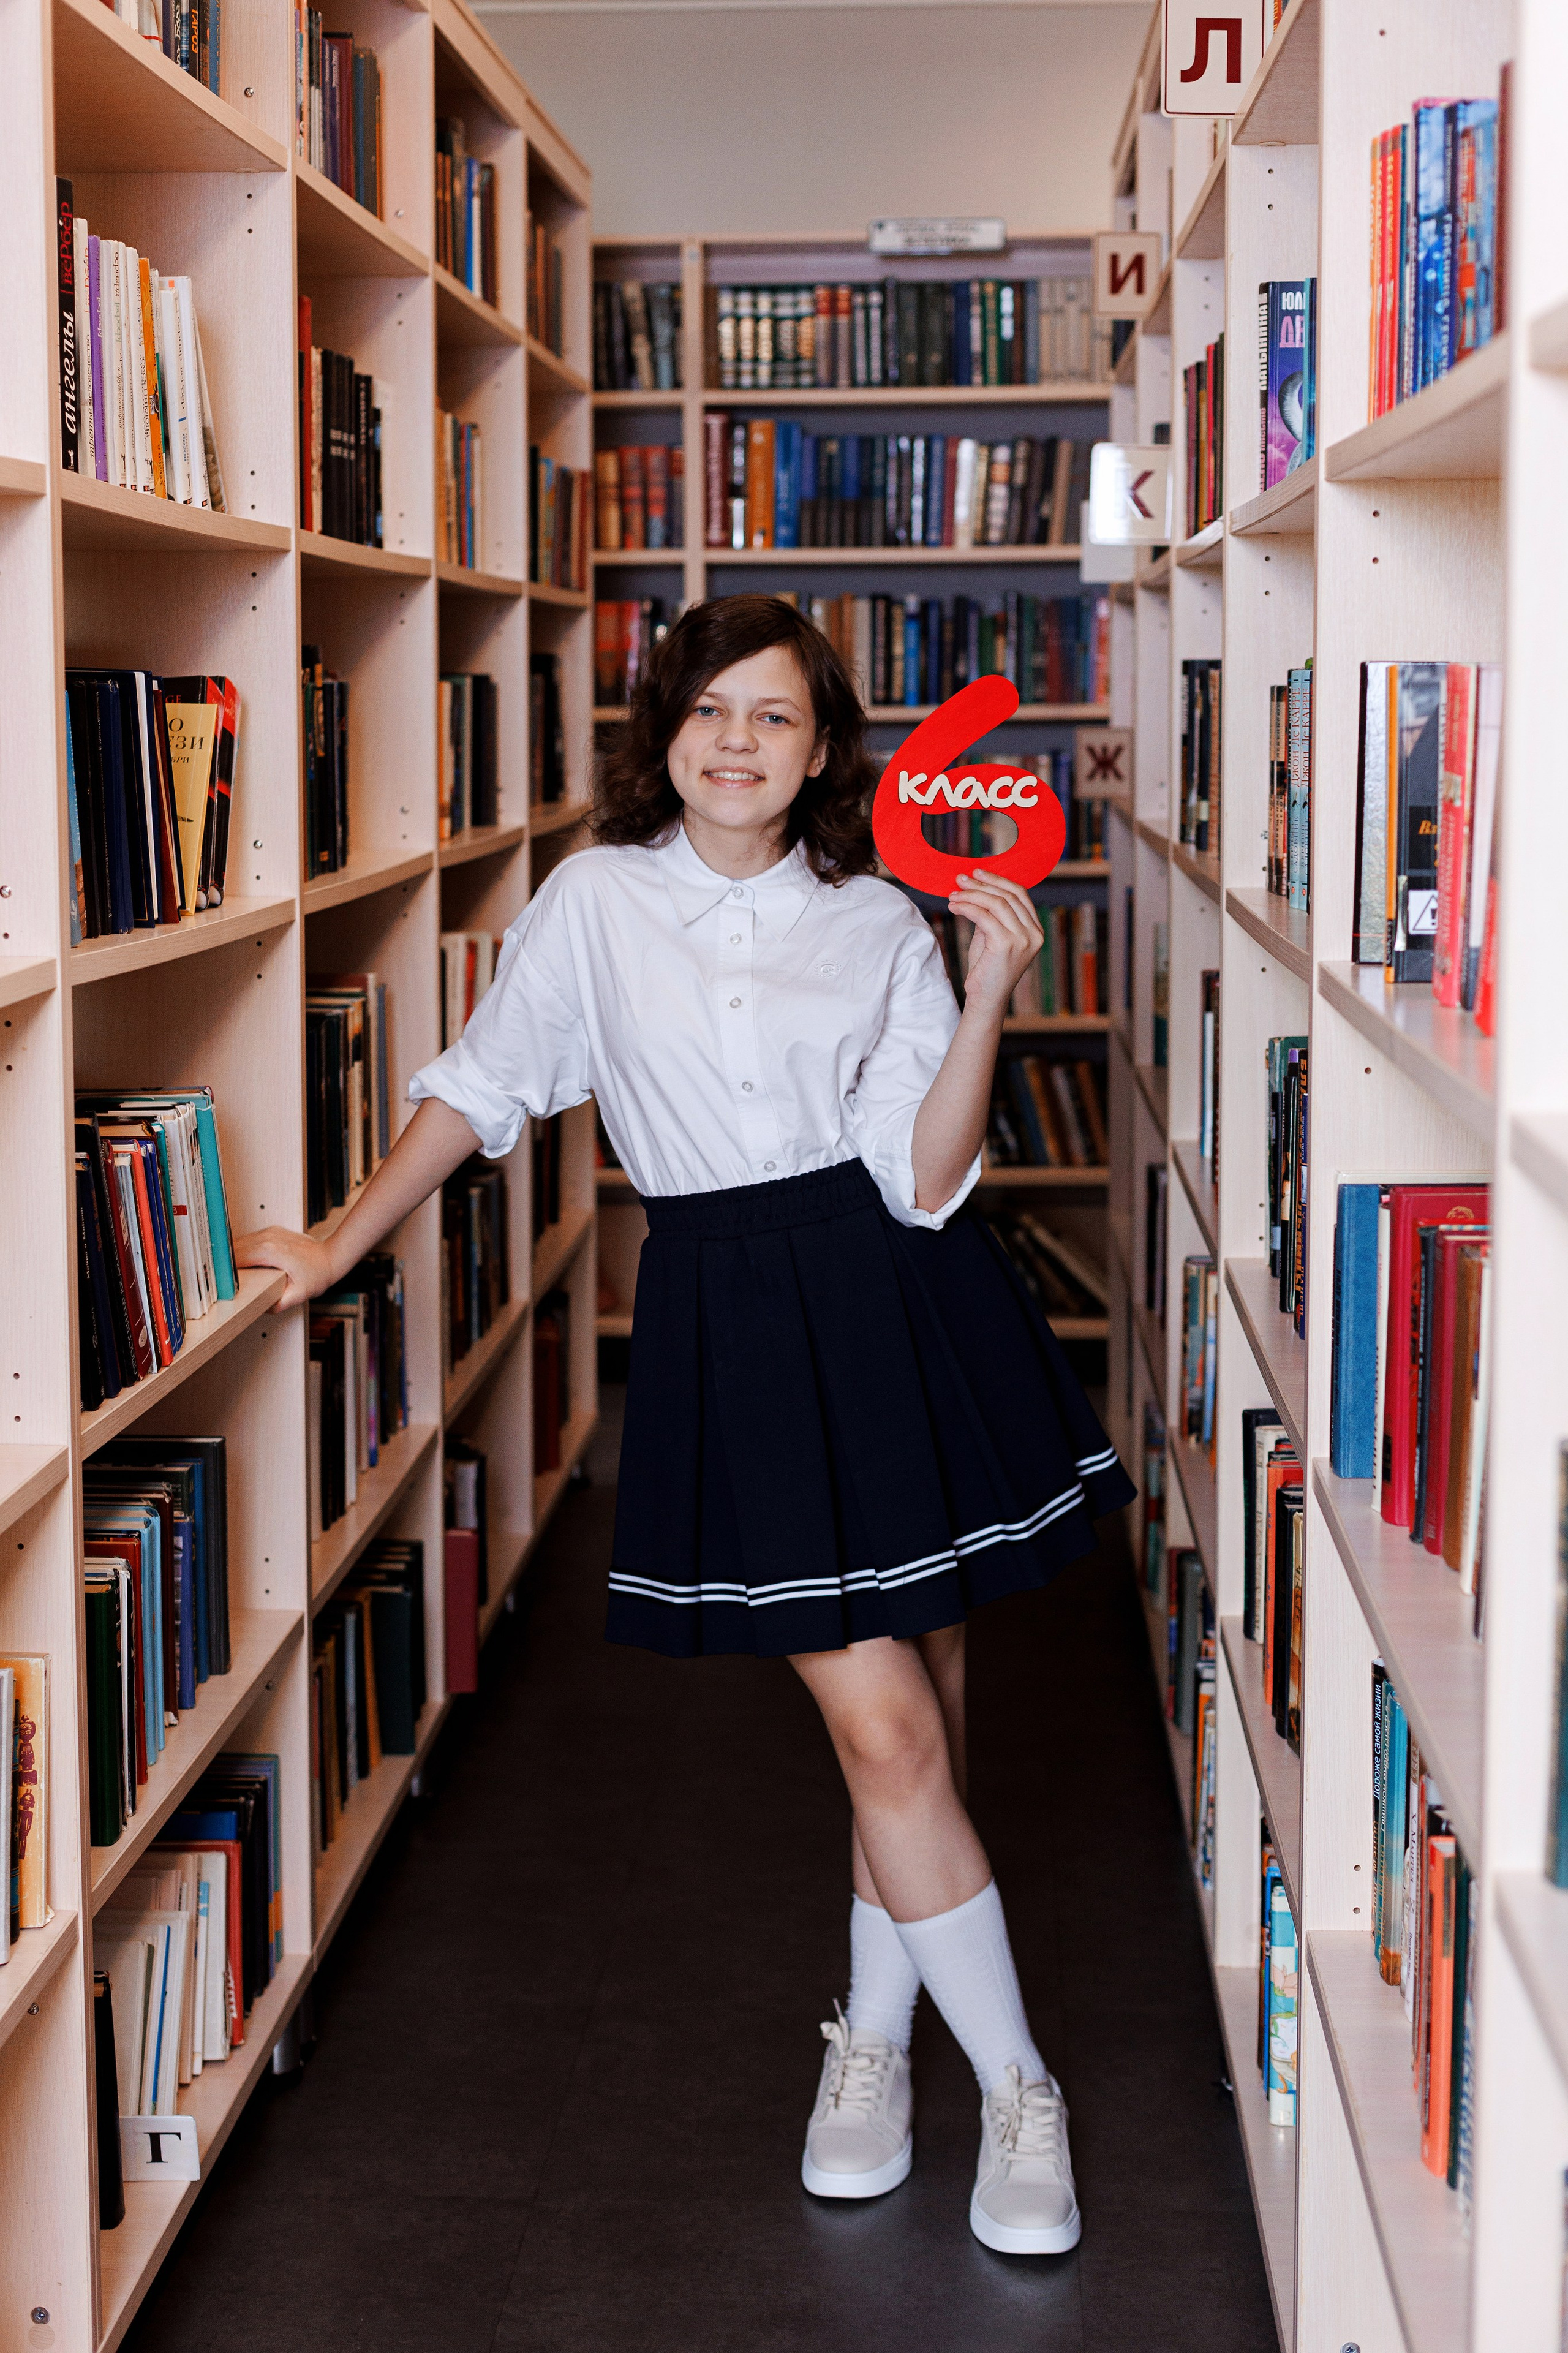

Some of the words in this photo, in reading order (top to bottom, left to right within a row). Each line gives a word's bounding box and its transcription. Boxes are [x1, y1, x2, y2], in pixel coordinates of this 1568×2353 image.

[1180, 18, 1242, 83] Л
[1110, 252, 1146, 296] И
[1281, 291, 1306, 311] ЮЛ
[1259, 303, 1267, 390] ЛАТЫНИНА
[63, 311, 76, 434] ангелы
[1086, 745, 1125, 782] Ж
[143, 2132, 181, 2164] Г
